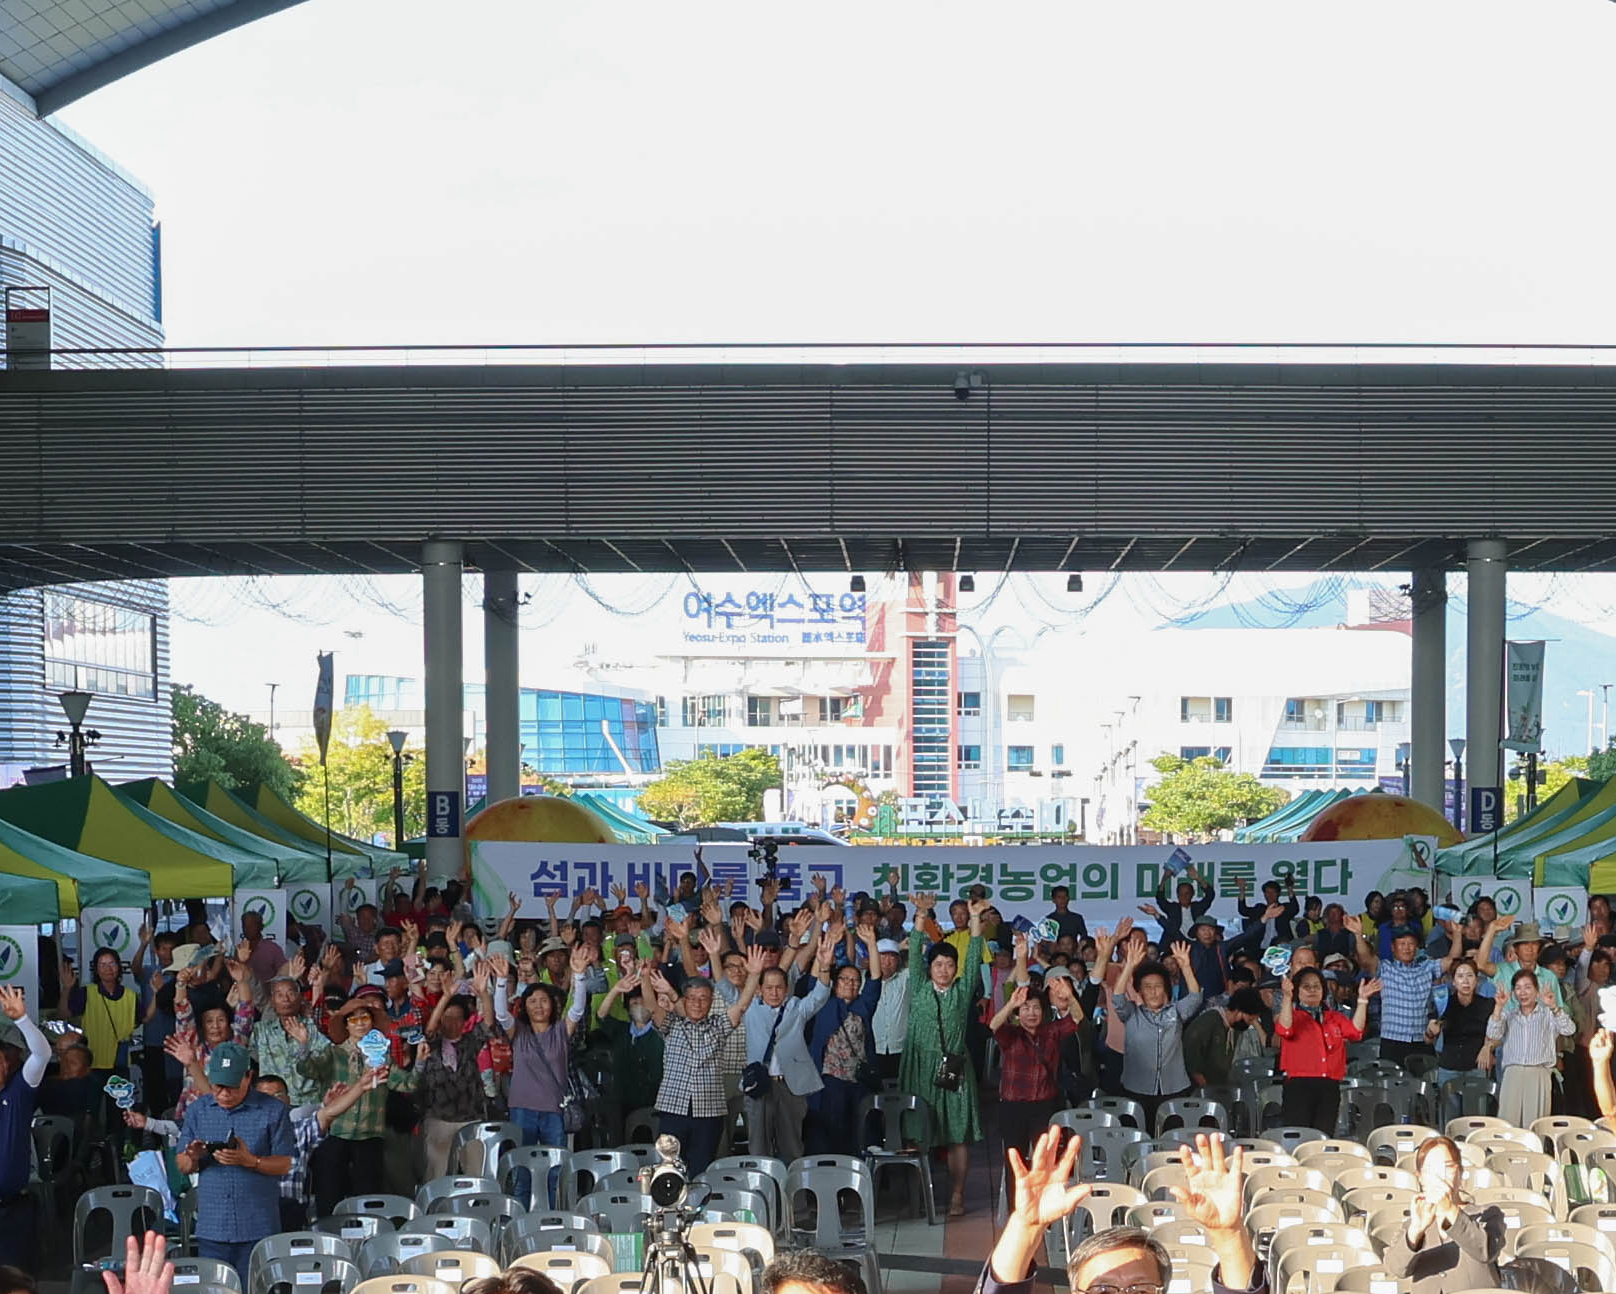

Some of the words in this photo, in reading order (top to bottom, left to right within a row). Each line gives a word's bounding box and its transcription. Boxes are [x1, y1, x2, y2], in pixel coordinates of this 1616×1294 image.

[683, 591, 866, 631] 여수엑스포역
[683, 632, 746, 646] Yeosu-Expo
[750, 632, 789, 643] Station
[530, 861, 614, 899] 섬과
[872, 861, 1120, 902] 친환경농업의
[1271, 858, 1353, 897] 열다
